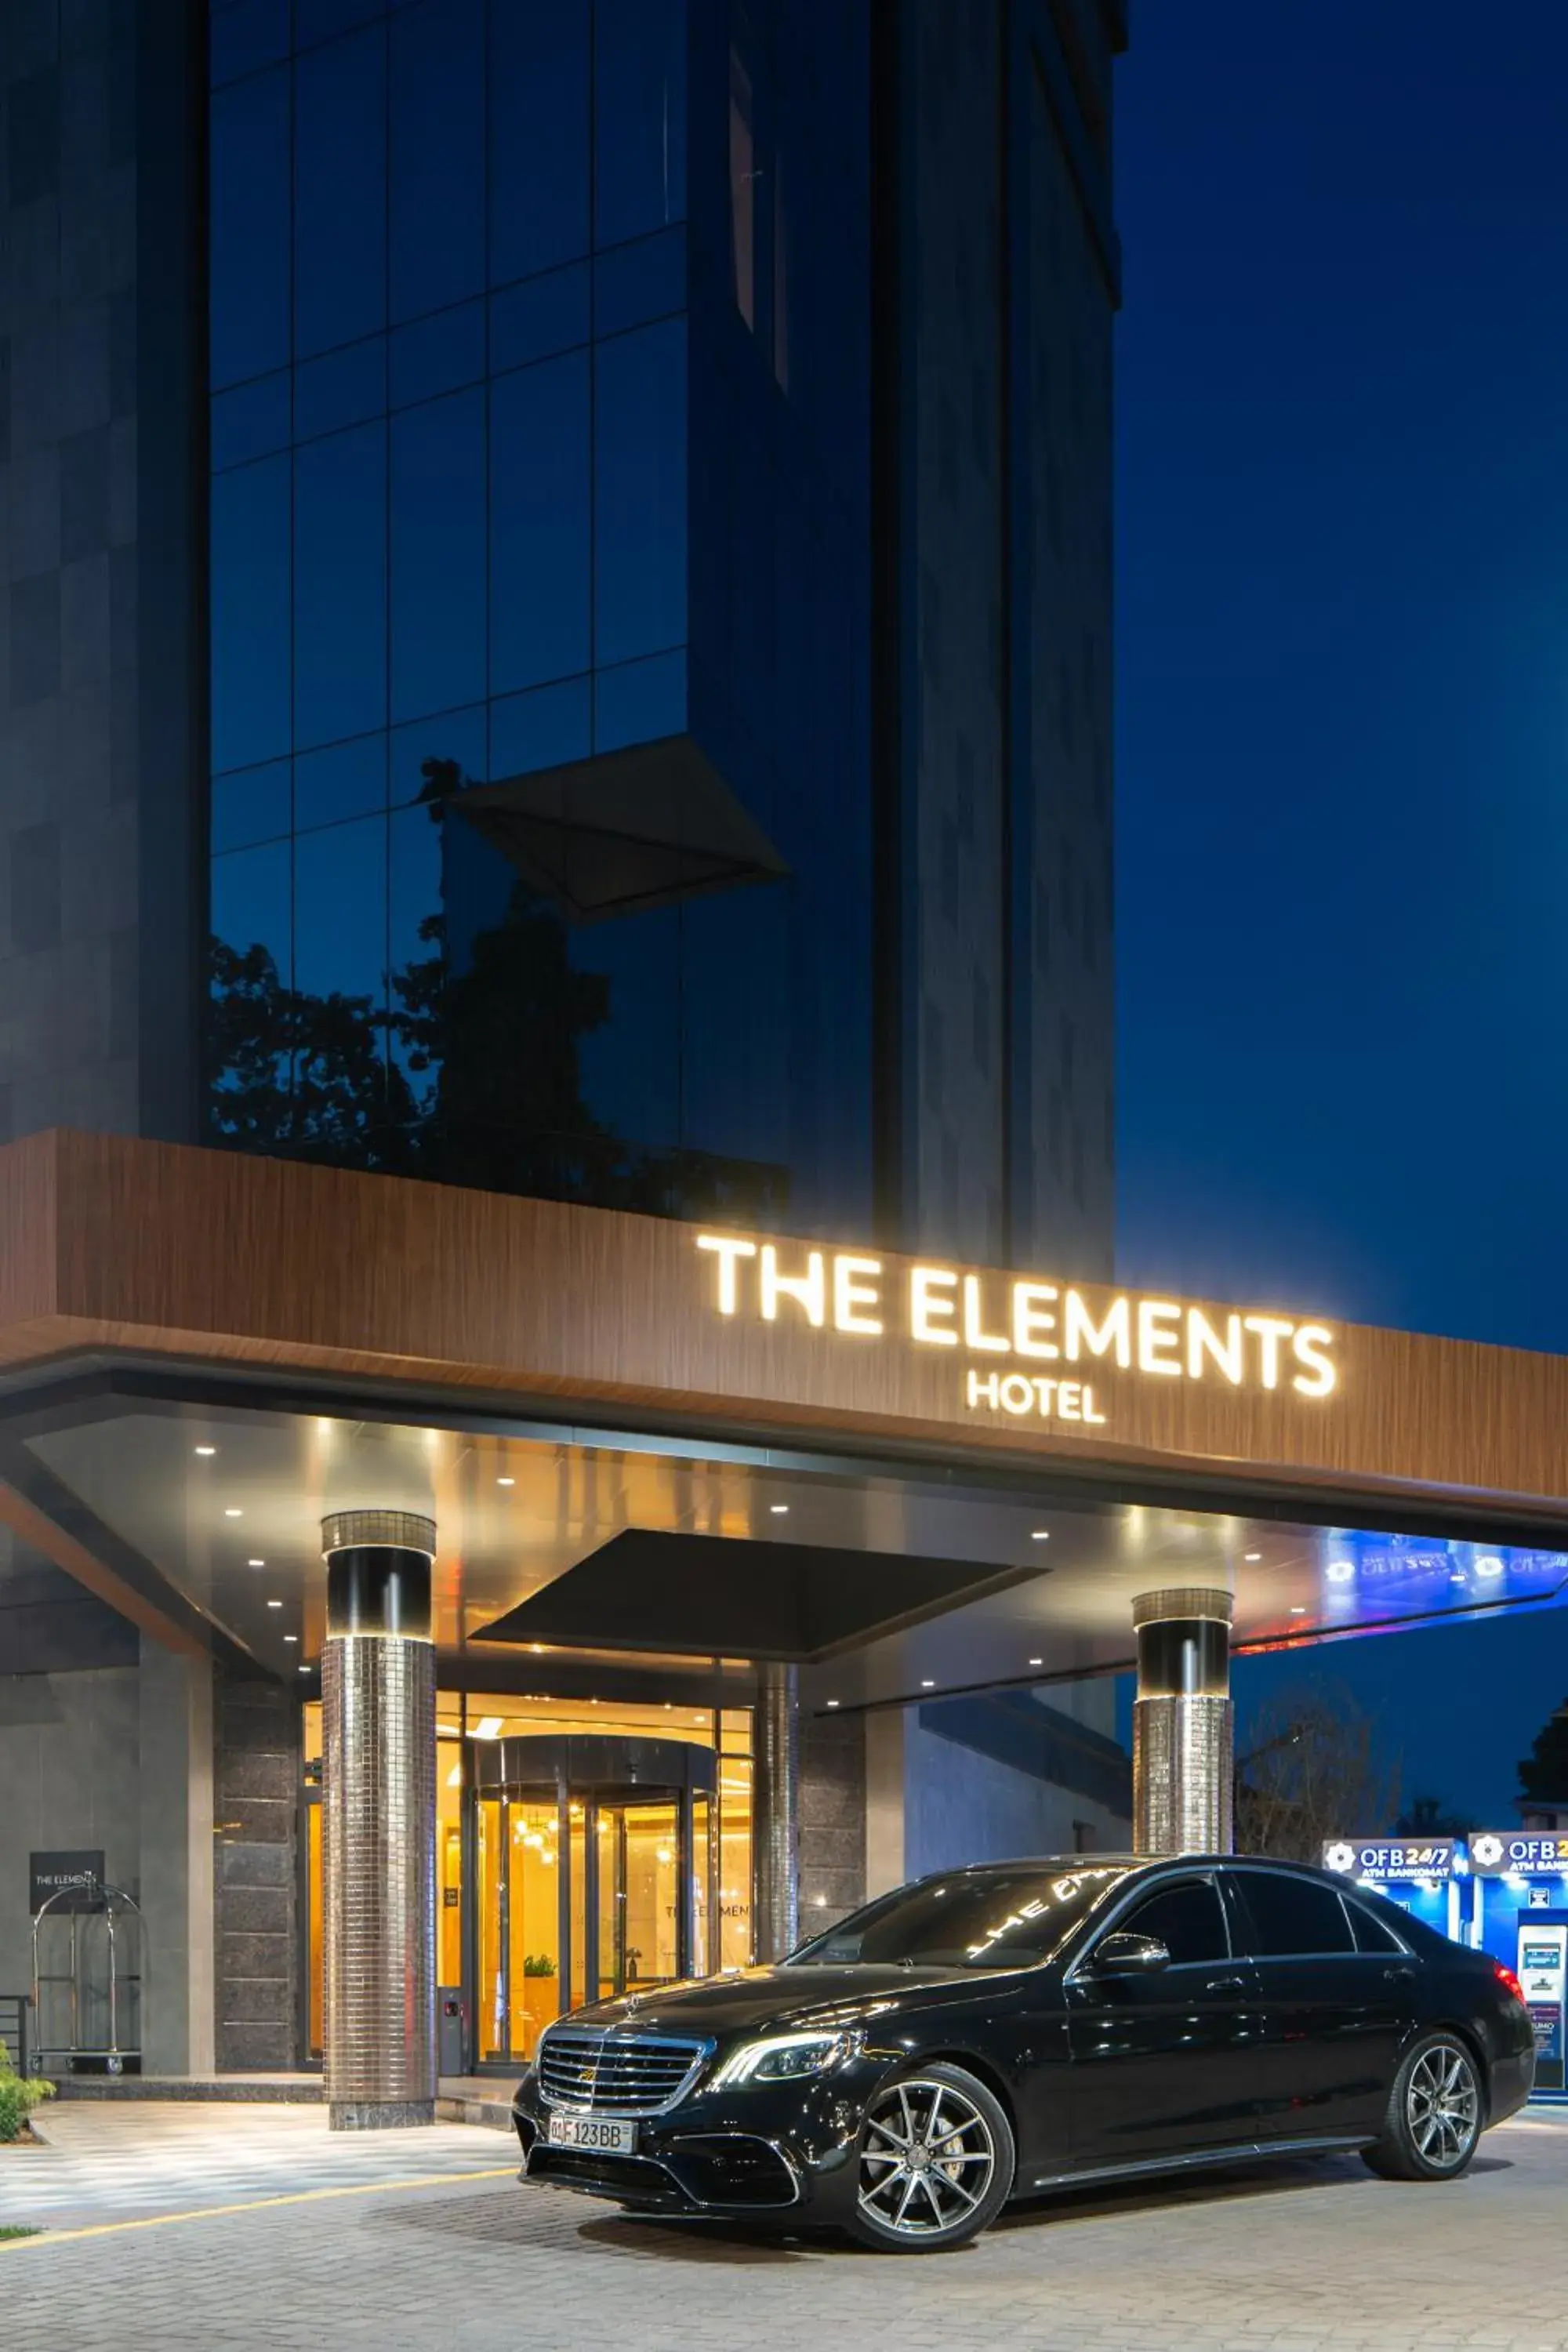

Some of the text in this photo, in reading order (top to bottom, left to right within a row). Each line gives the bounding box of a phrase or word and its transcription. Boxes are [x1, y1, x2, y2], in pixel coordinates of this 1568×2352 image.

[695, 1233, 1338, 1398] THE ELEMENTS
[966, 1369, 1107, 1424] HOTEL
[1360, 1847, 1449, 1867] OFB 24/7
[1508, 1842, 1555, 1860] OFB
[1362, 1867, 1450, 1878] ATM BANKOMAT
[1509, 1862, 1535, 1871] ATM
[564, 2120, 622, 2147] F123BB
